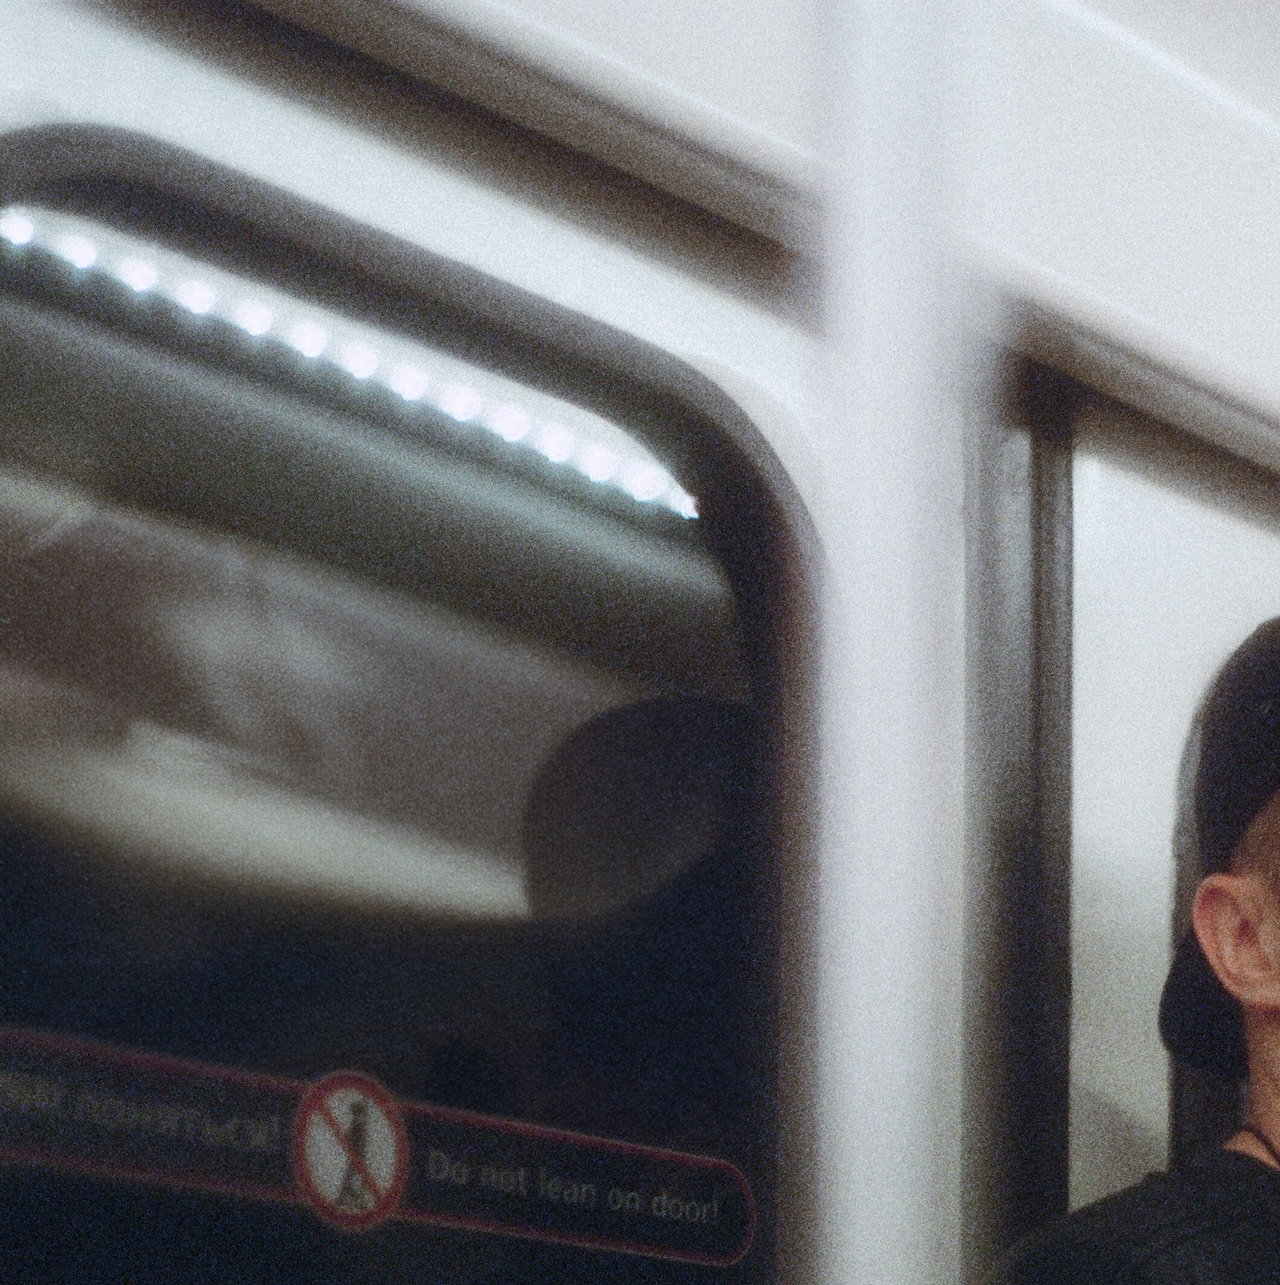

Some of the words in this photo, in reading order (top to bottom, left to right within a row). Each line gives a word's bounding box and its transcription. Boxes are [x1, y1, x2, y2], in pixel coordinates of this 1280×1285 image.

[428, 1148, 470, 1186] Do
[479, 1167, 528, 1197] not
[538, 1167, 597, 1207] lean
[608, 1187, 641, 1211] on
[651, 1188, 720, 1225] door!
